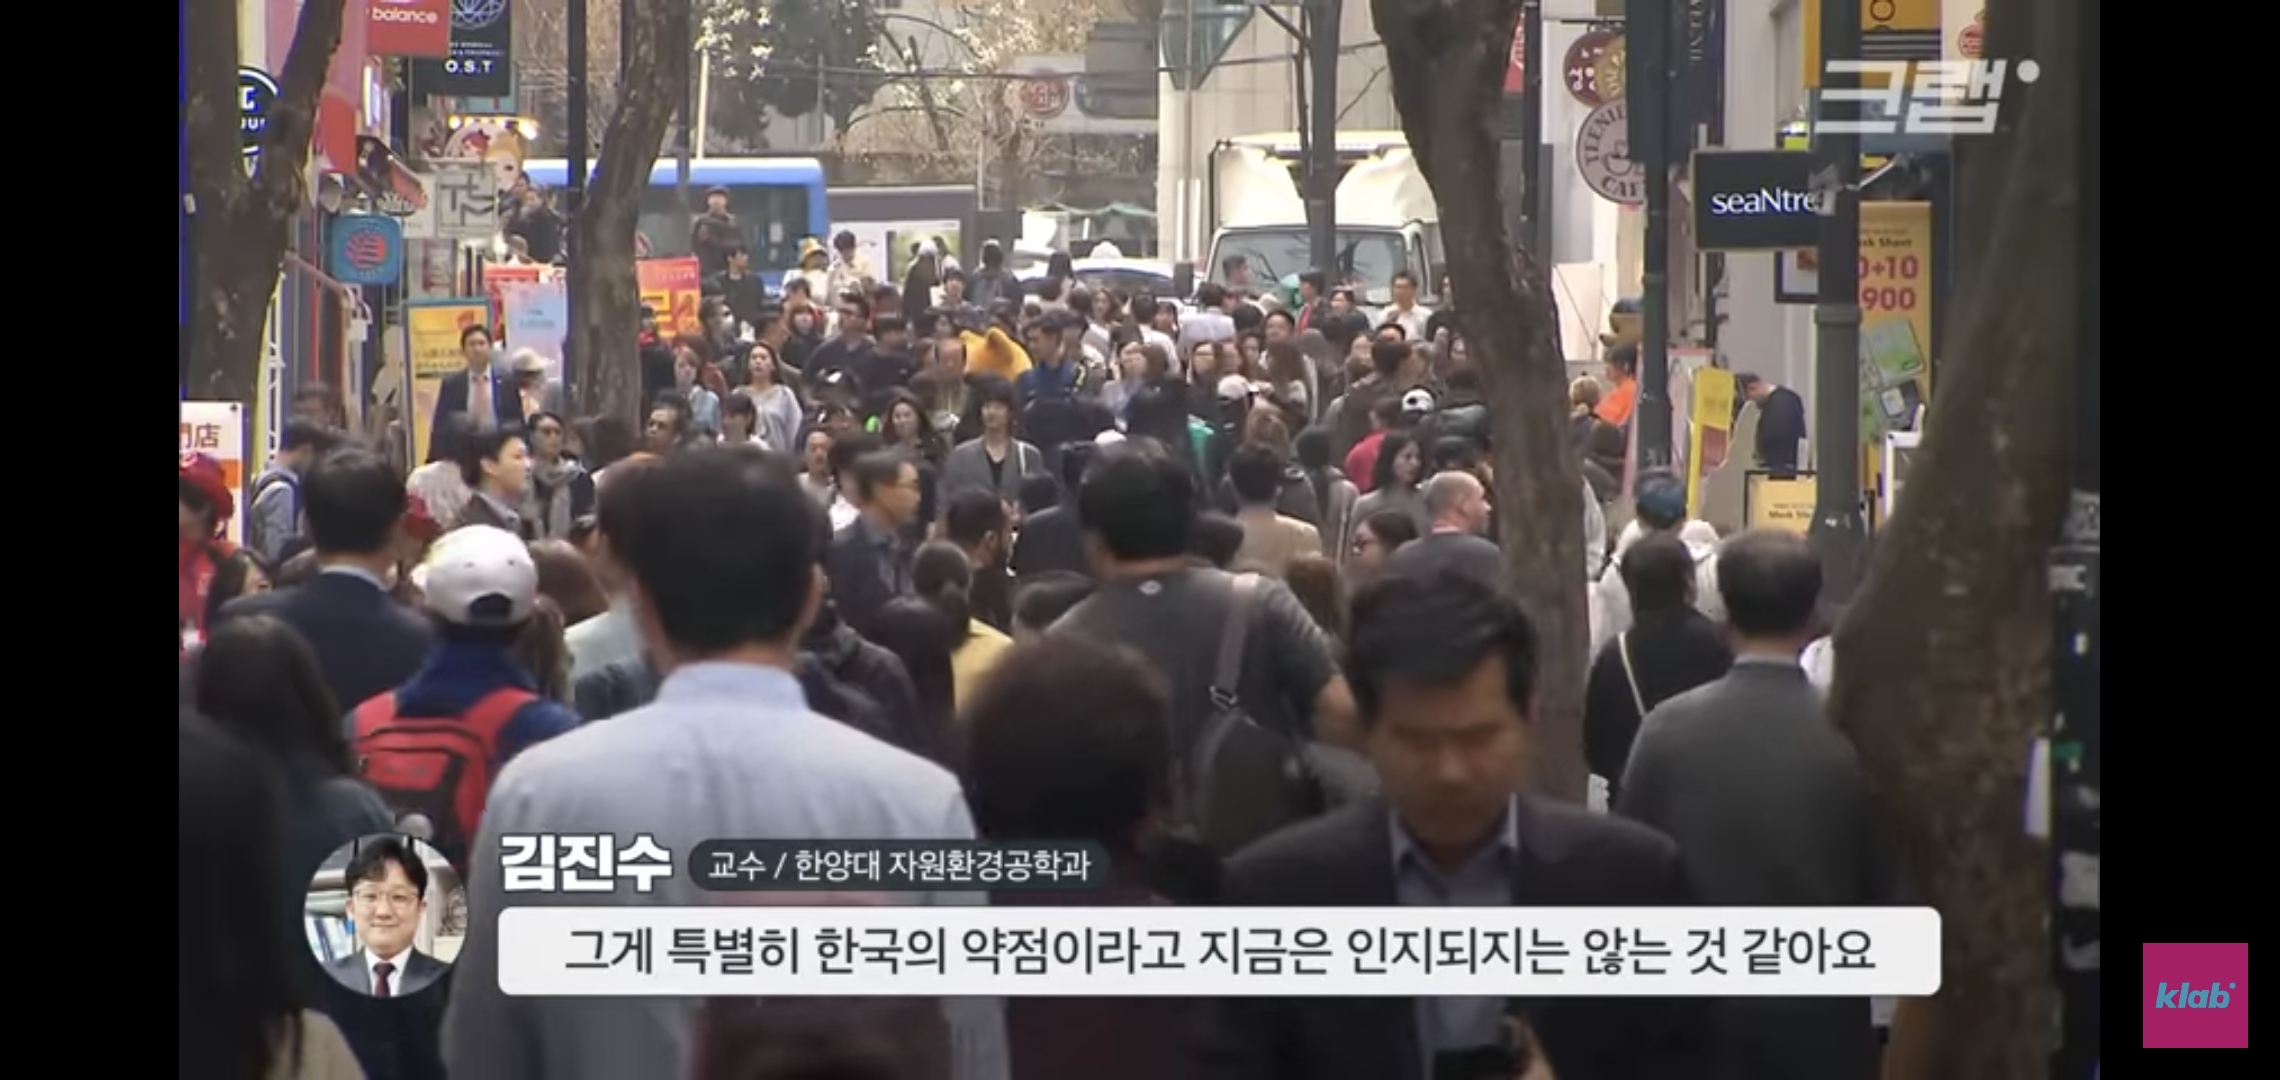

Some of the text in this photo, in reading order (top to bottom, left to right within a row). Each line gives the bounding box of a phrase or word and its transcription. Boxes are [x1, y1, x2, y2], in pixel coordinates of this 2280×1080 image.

[371, 6, 439, 24] balance
[444, 60, 494, 74] O.S.T
[1602, 174, 1641, 198] CAF
[1711, 187, 1820, 214] seaNtre
[1859, 256, 1919, 280] 0+10
[1862, 287, 1917, 311] 900
